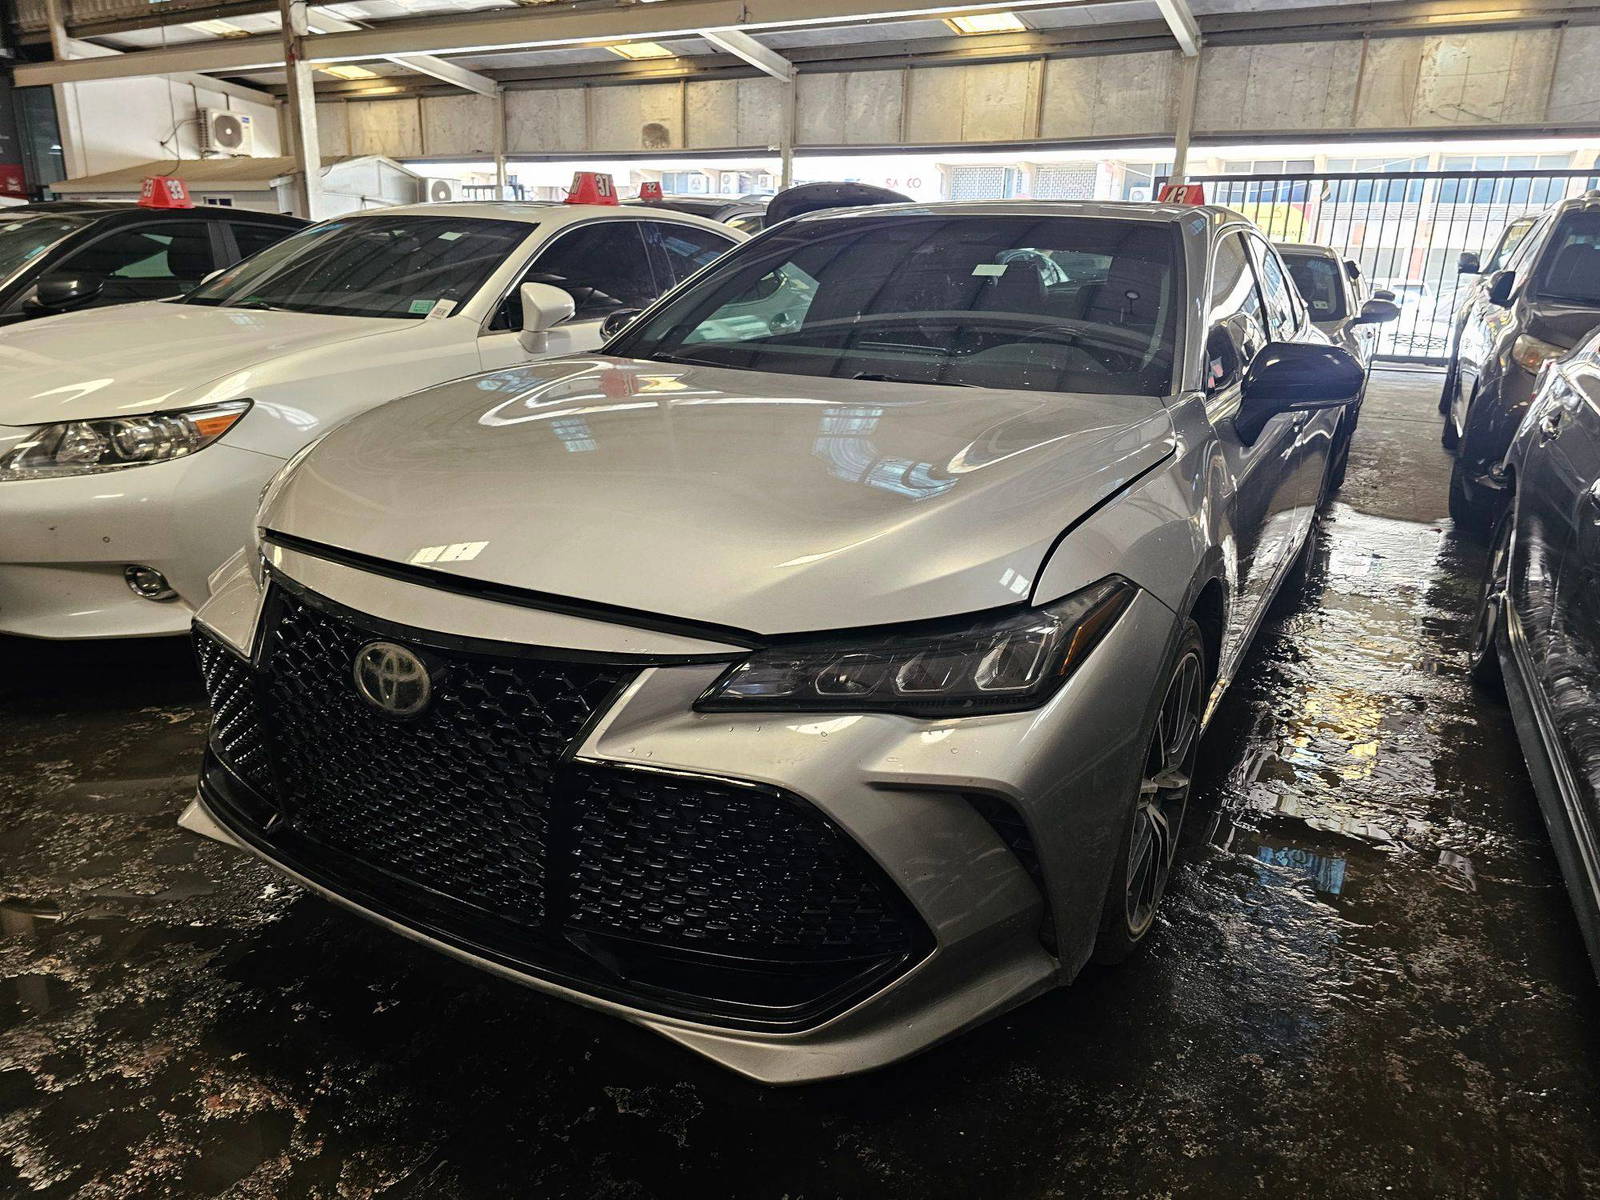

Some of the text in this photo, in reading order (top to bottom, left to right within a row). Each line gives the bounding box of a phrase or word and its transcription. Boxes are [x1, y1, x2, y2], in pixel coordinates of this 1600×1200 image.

[166, 180, 185, 200] 33
[595, 173, 611, 197] 37
[646, 182, 656, 193] 32
[1164, 186, 1188, 205] 43
